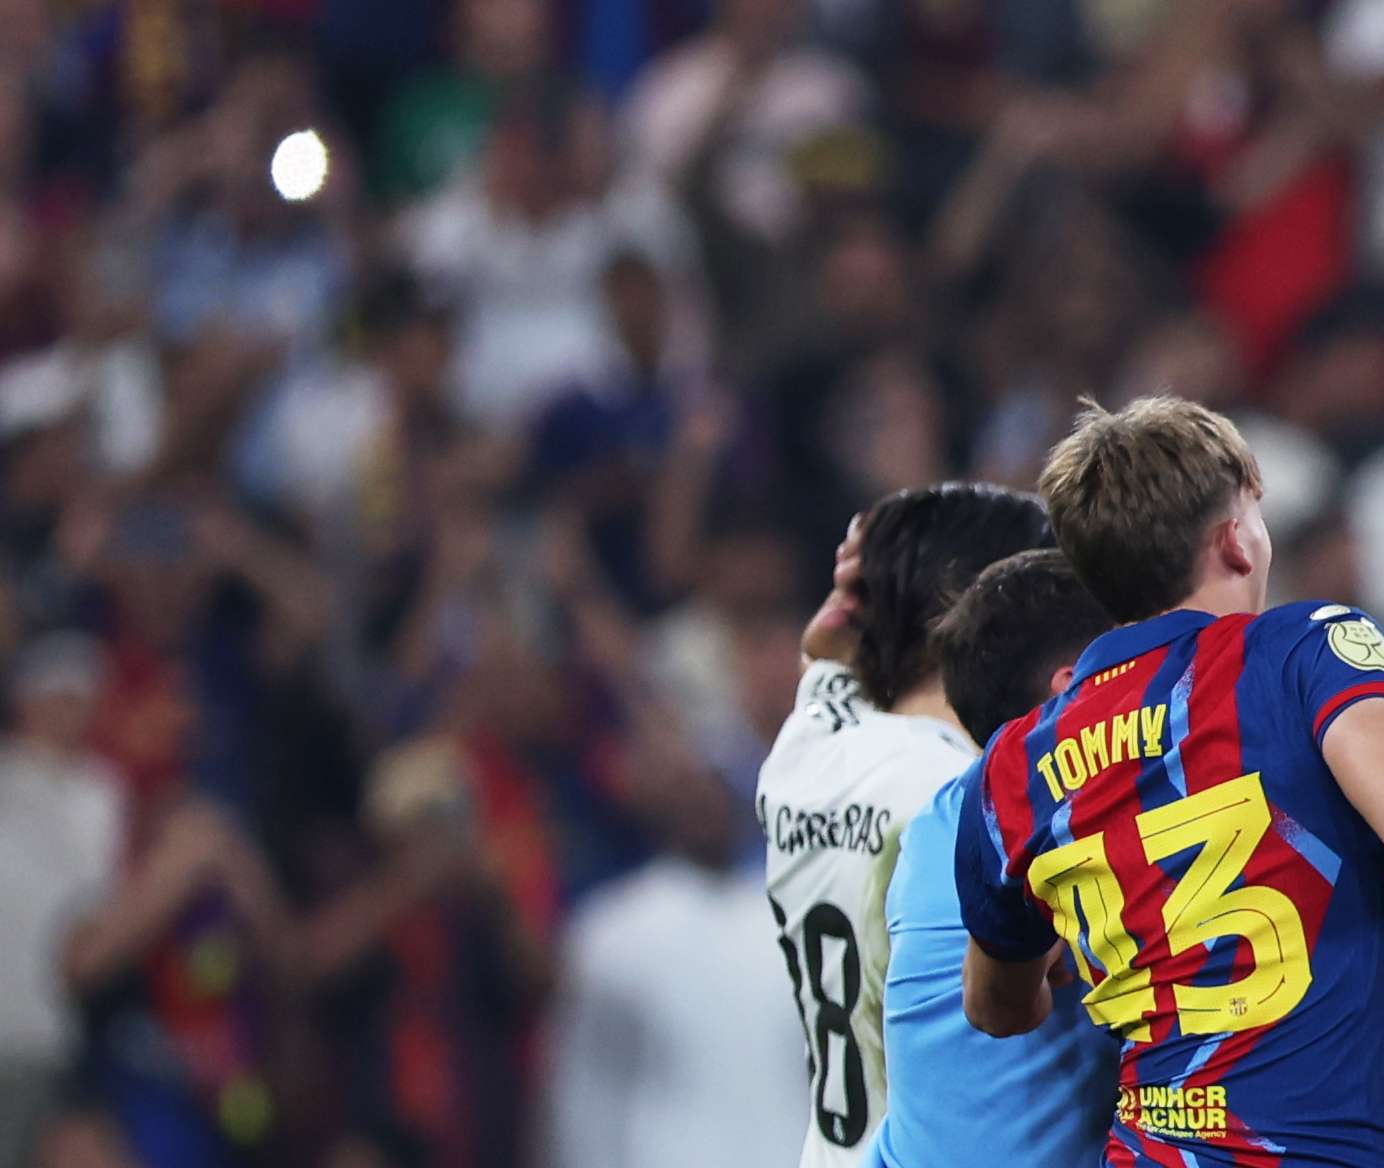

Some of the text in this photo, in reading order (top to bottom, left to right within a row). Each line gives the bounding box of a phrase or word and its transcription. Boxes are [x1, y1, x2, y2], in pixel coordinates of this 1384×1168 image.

[1036, 703, 1167, 803] TOMMY
[1027, 771, 1313, 1042] 43
[1136, 1108, 1227, 1130] ACNUR
[1139, 1085, 1227, 1108] UNHCR
